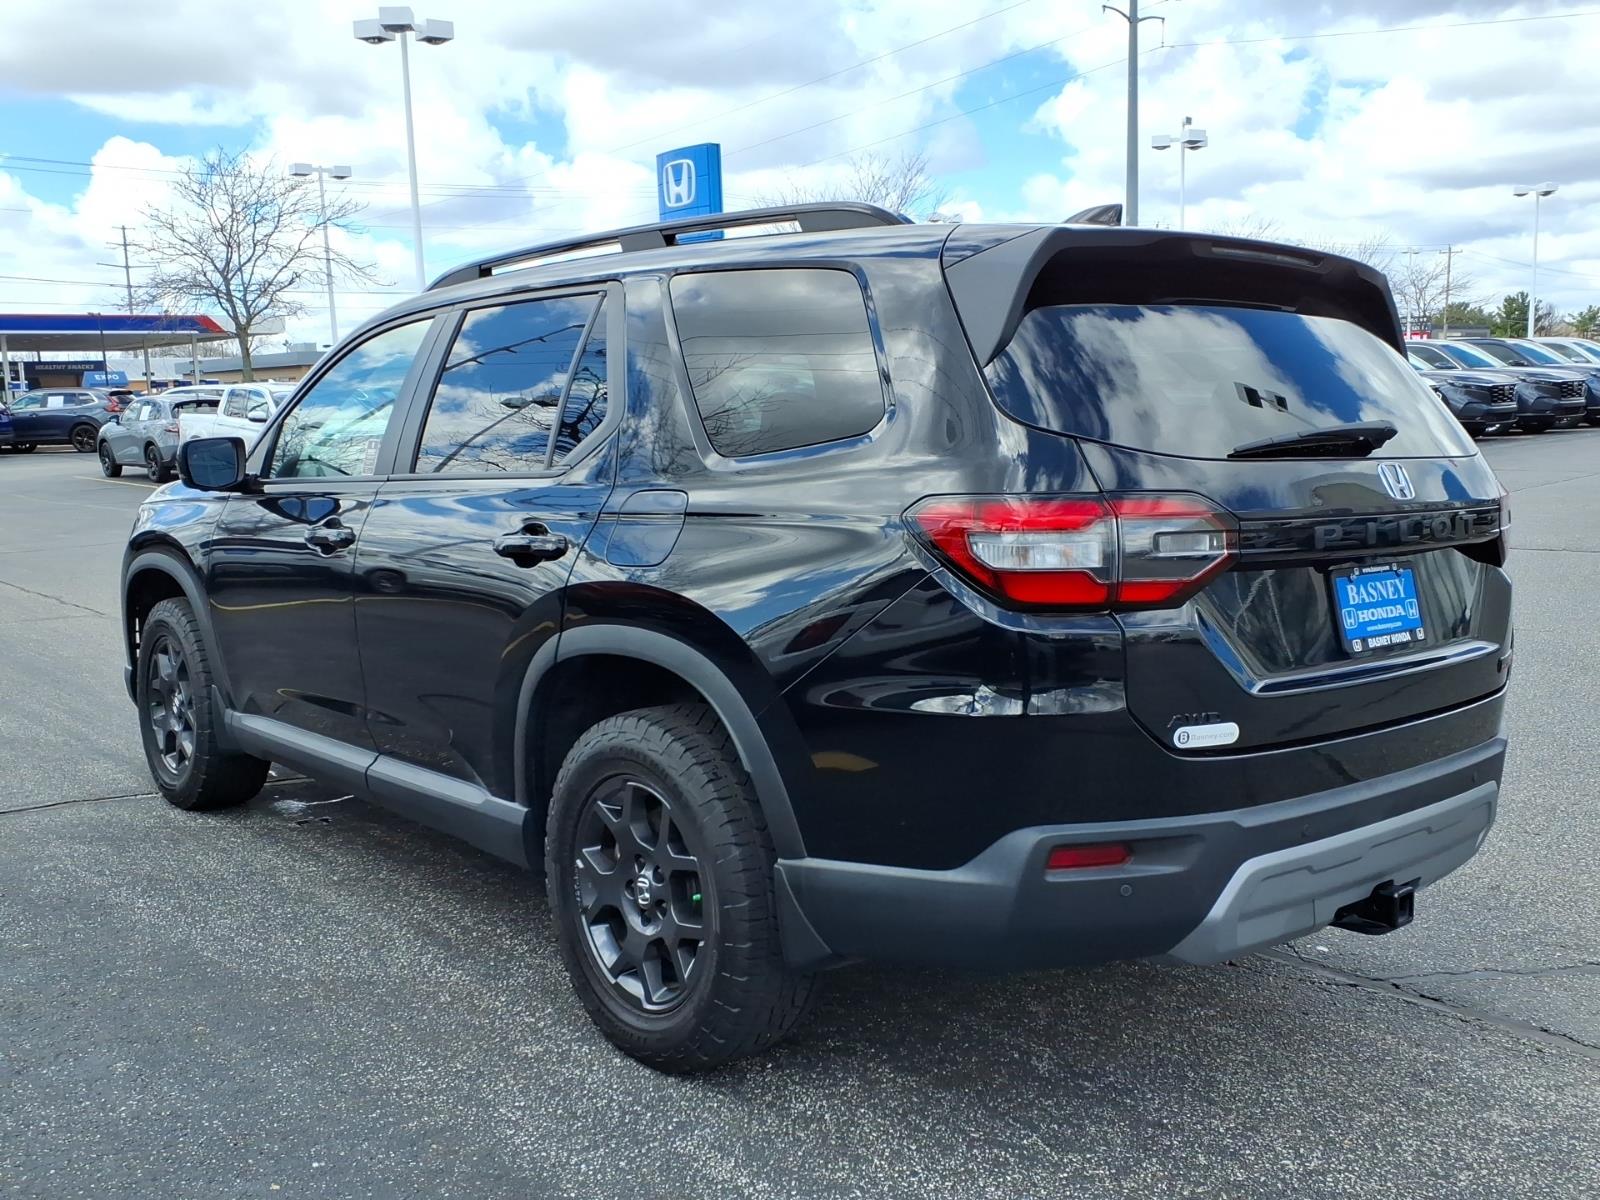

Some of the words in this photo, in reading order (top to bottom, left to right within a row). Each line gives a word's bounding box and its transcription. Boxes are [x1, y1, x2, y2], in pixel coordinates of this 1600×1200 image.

[1314, 510, 1477, 550] PILOT
[1346, 578, 1406, 605] BASNEY
[1357, 605, 1406, 622] HONDA
[1367, 634, 1391, 648] BASNEY
[1390, 631, 1412, 644] HONDA
